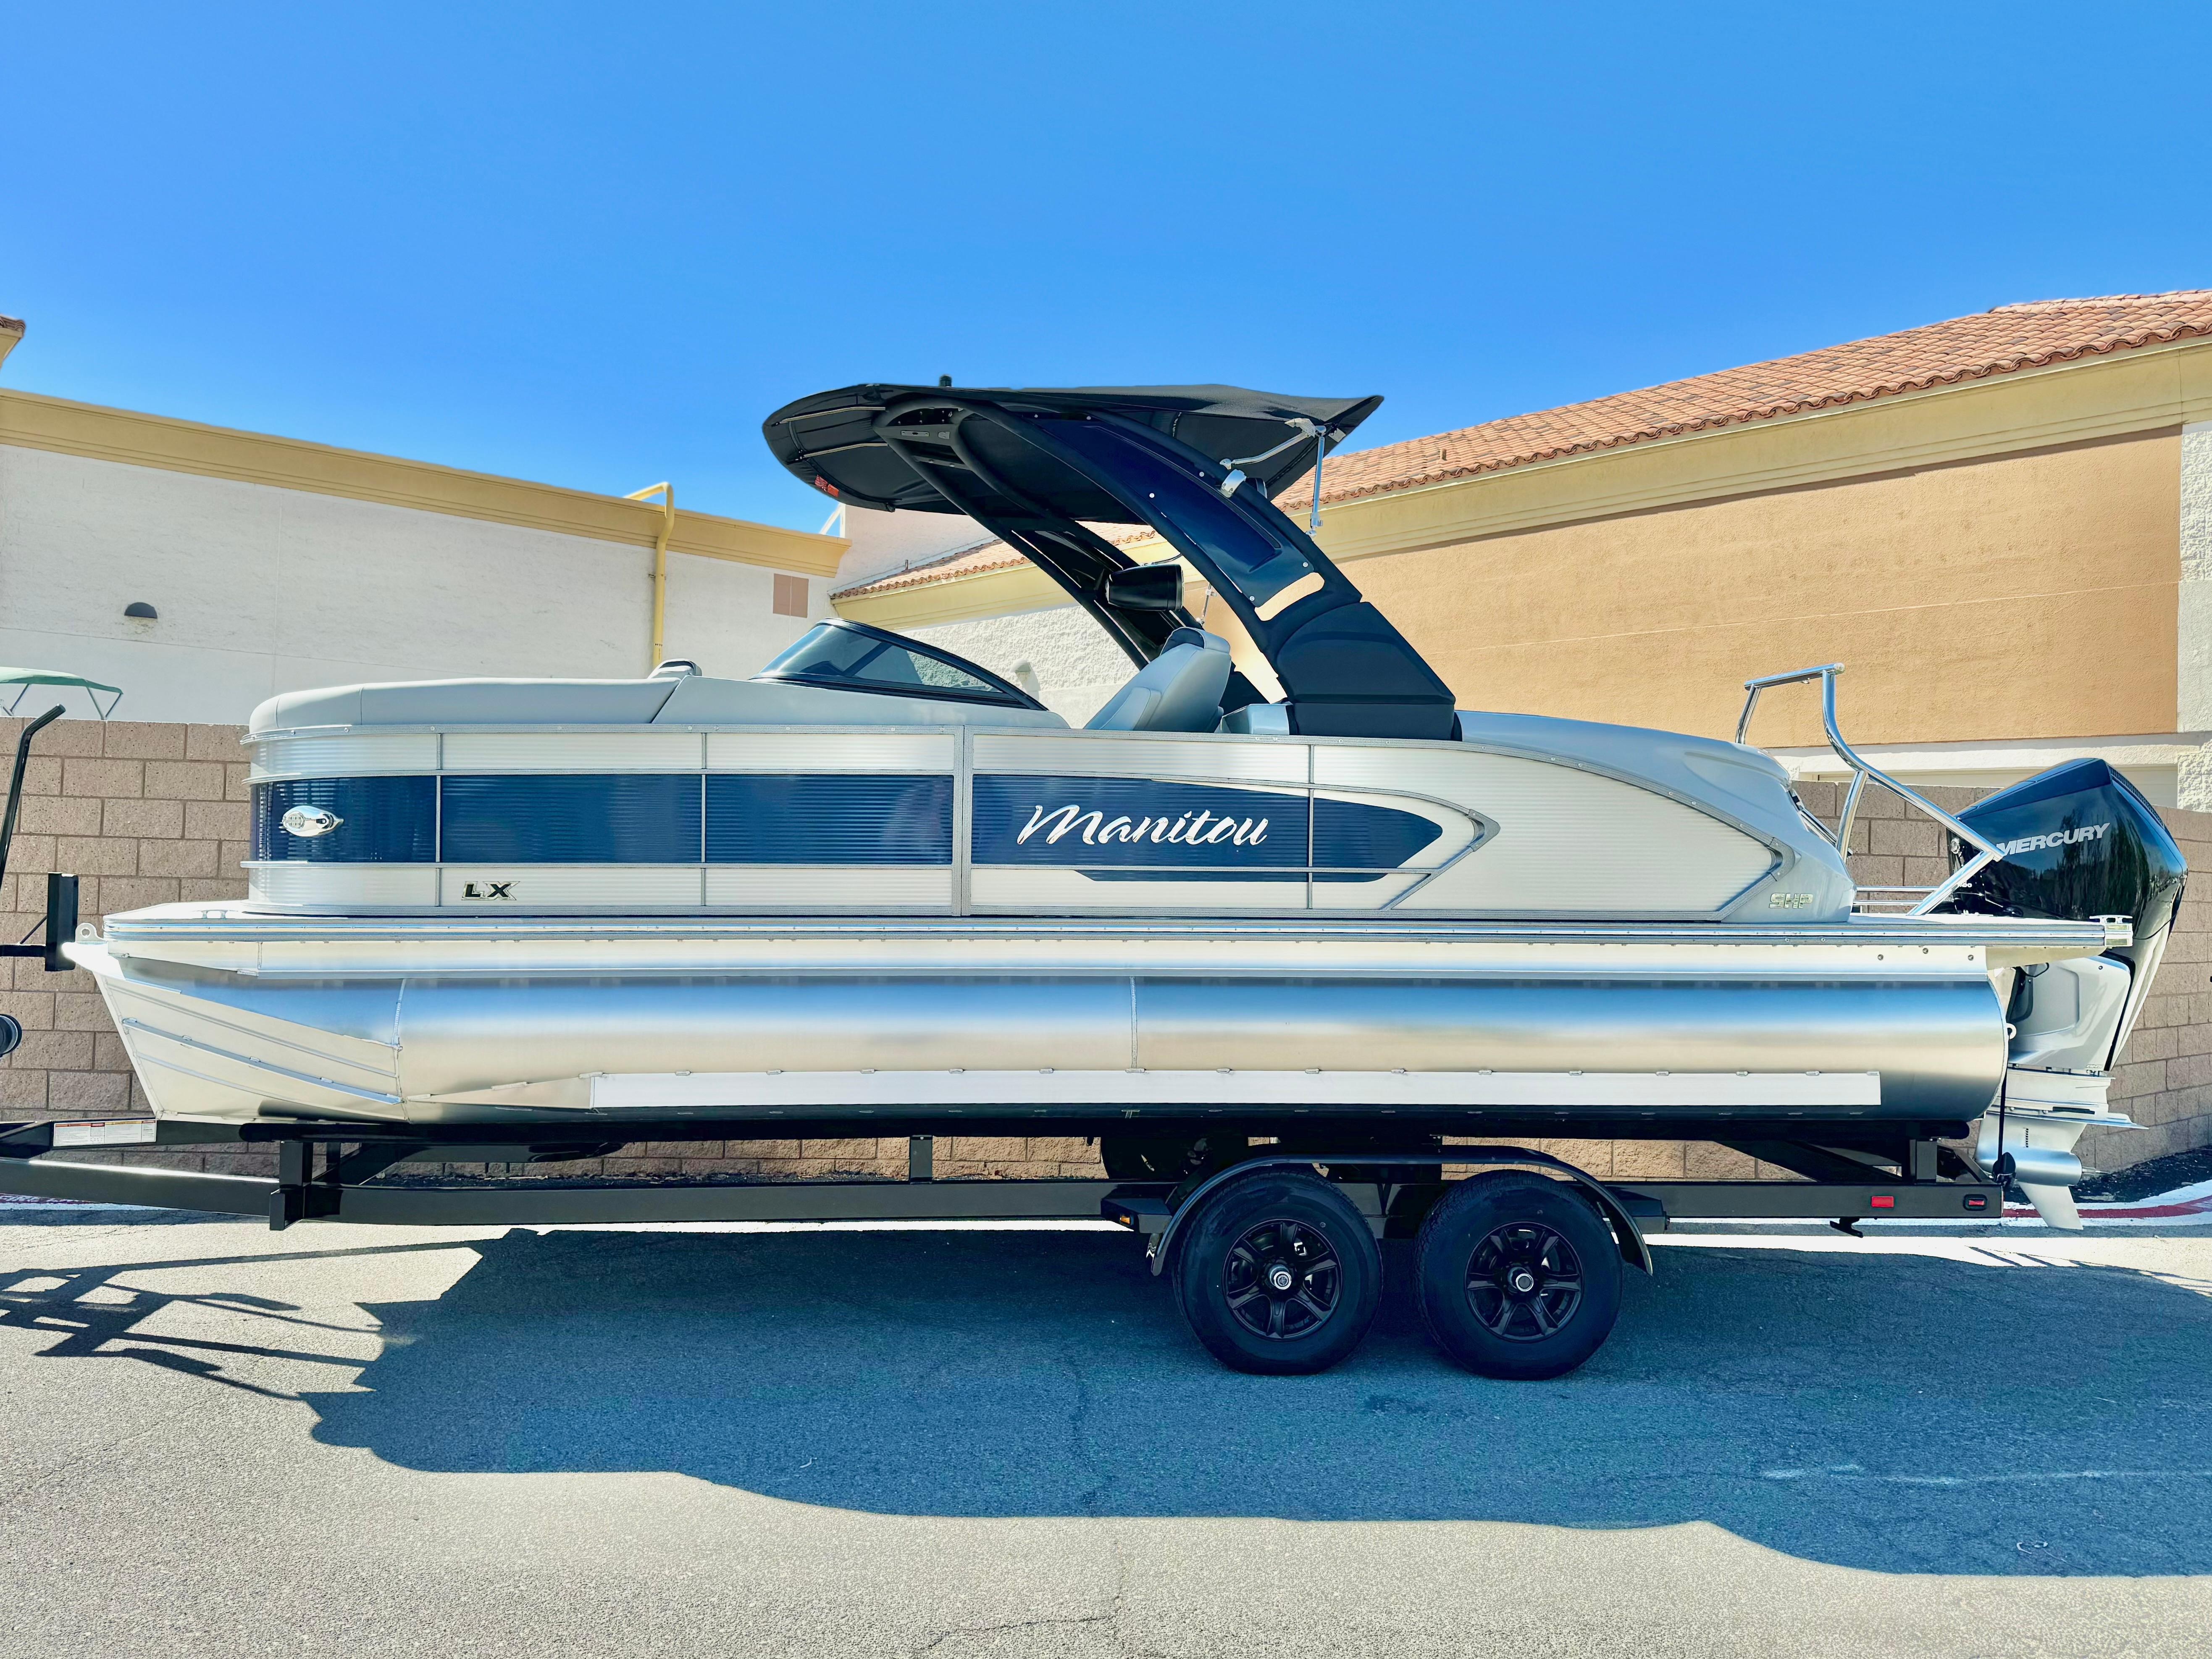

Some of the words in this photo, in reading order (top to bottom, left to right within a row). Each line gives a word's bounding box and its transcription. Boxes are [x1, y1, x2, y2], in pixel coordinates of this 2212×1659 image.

[1016, 804, 1269, 846] Manitou
[1996, 823, 2110, 856] MERCURY
[462, 881, 520, 900] LX
[1769, 893, 1814, 909] SHP
